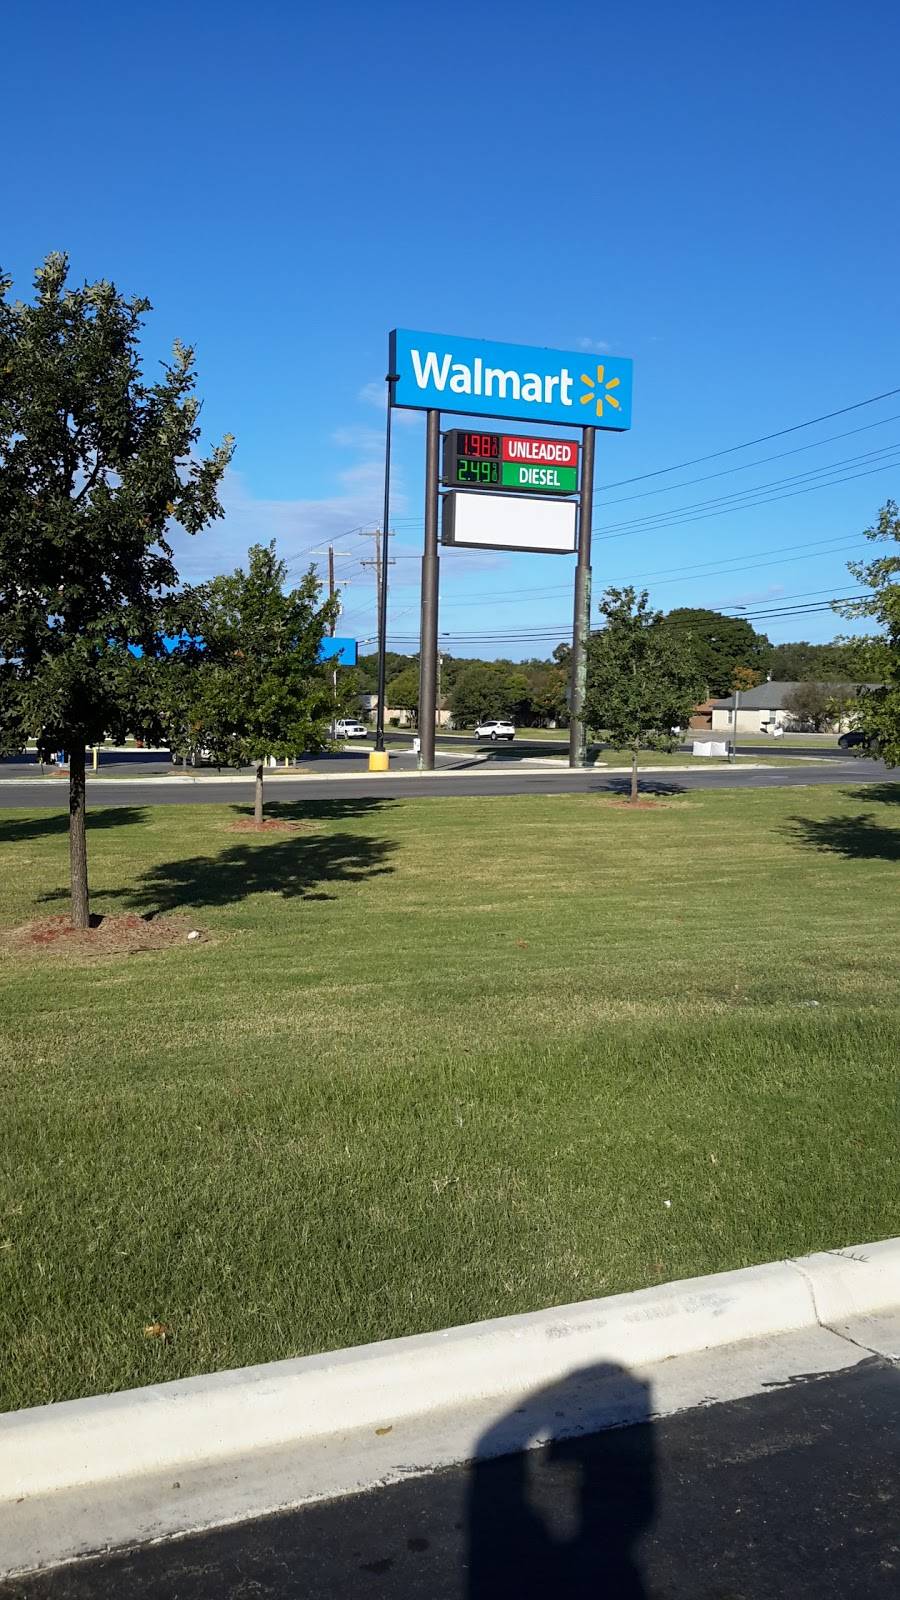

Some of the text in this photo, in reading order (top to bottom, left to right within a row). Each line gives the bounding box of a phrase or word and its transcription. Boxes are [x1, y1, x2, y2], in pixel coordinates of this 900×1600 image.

[410, 349, 573, 406] Walmart
[464, 434, 491, 457] 1.98
[508, 440, 571, 461] UNLEADED
[458, 460, 491, 482] 2.49
[519, 467, 560, 486] DIESEL
